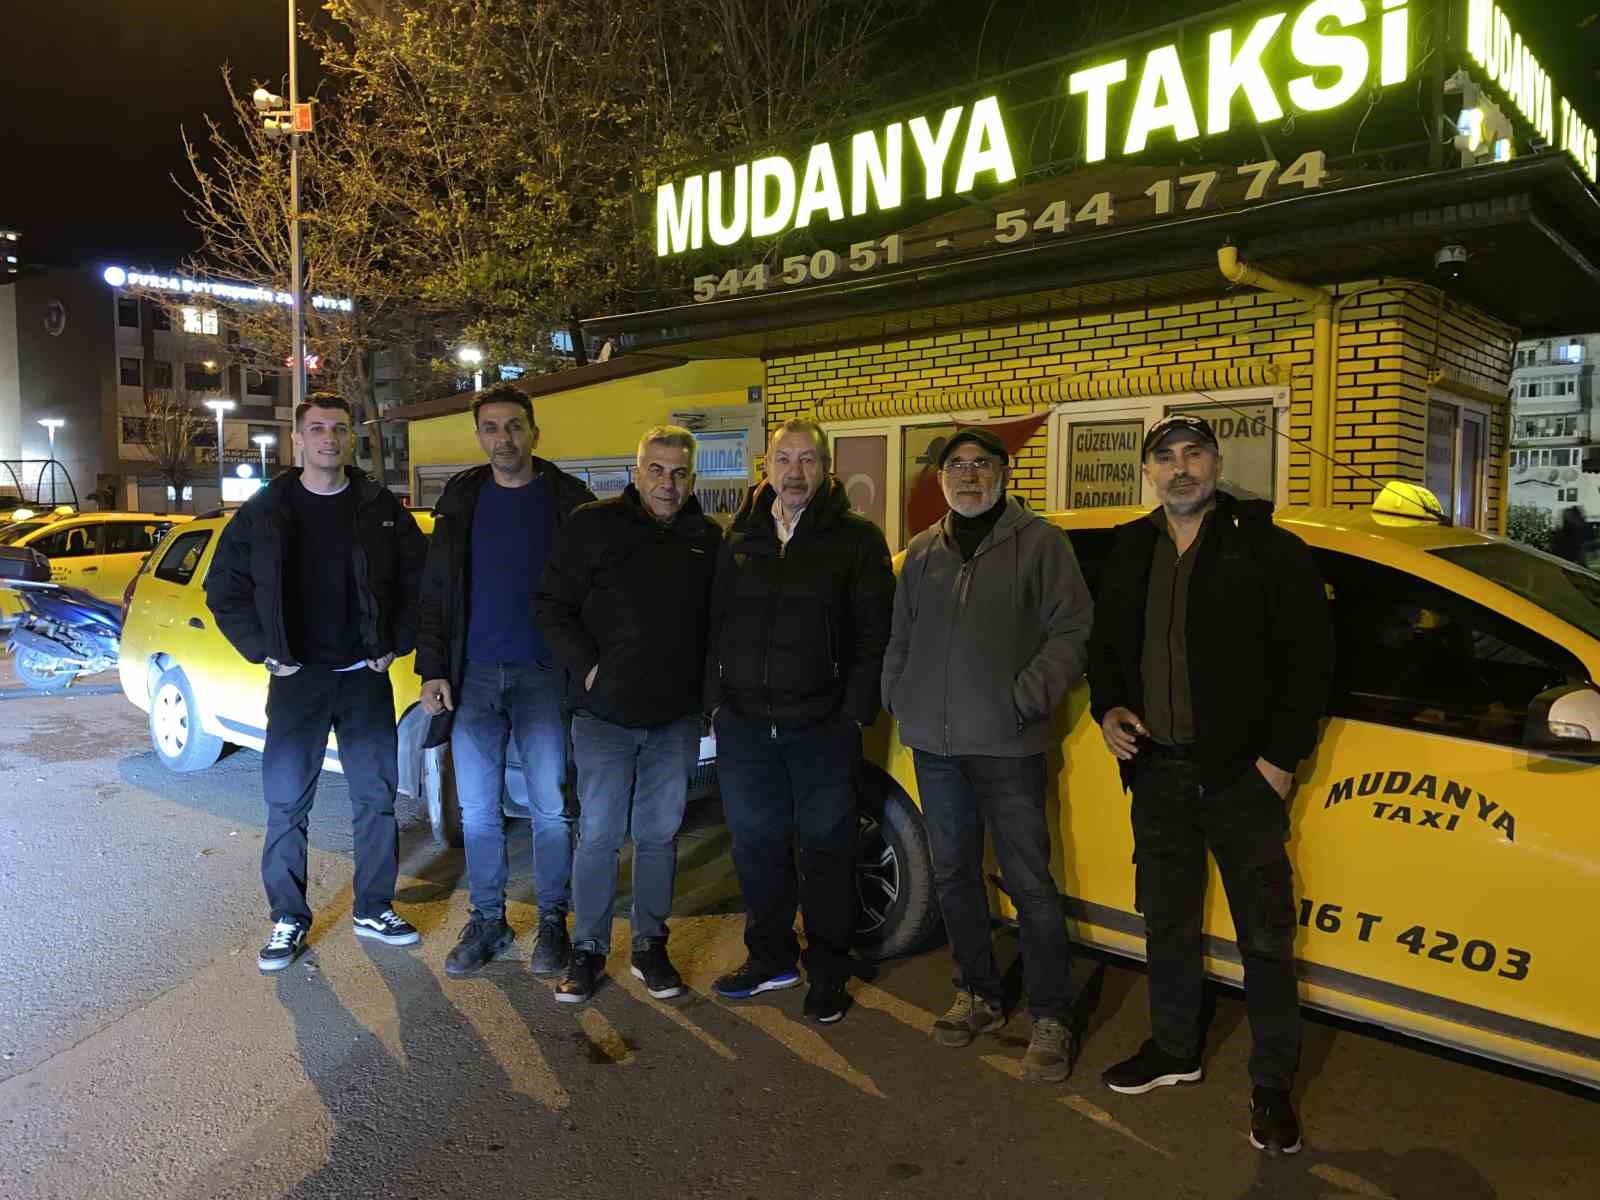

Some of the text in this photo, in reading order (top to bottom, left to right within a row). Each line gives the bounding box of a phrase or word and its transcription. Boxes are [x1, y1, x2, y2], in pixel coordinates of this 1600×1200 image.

[656, 95, 1017, 257] MUDANYA
[693, 263, 769, 302] 544
[782, 249, 837, 285] 50
[849, 234, 901, 272] 51
[994, 191, 1114, 243] 544
[1144, 171, 1219, 216] 17
[1237, 149, 1329, 200] 74
[1076, 427, 1137, 453] GÜZELYALI
[1324, 770, 1516, 842] MUDANYA
[1371, 801, 1460, 831] TAXI
[1298, 898, 1532, 982] 16 T 4203
